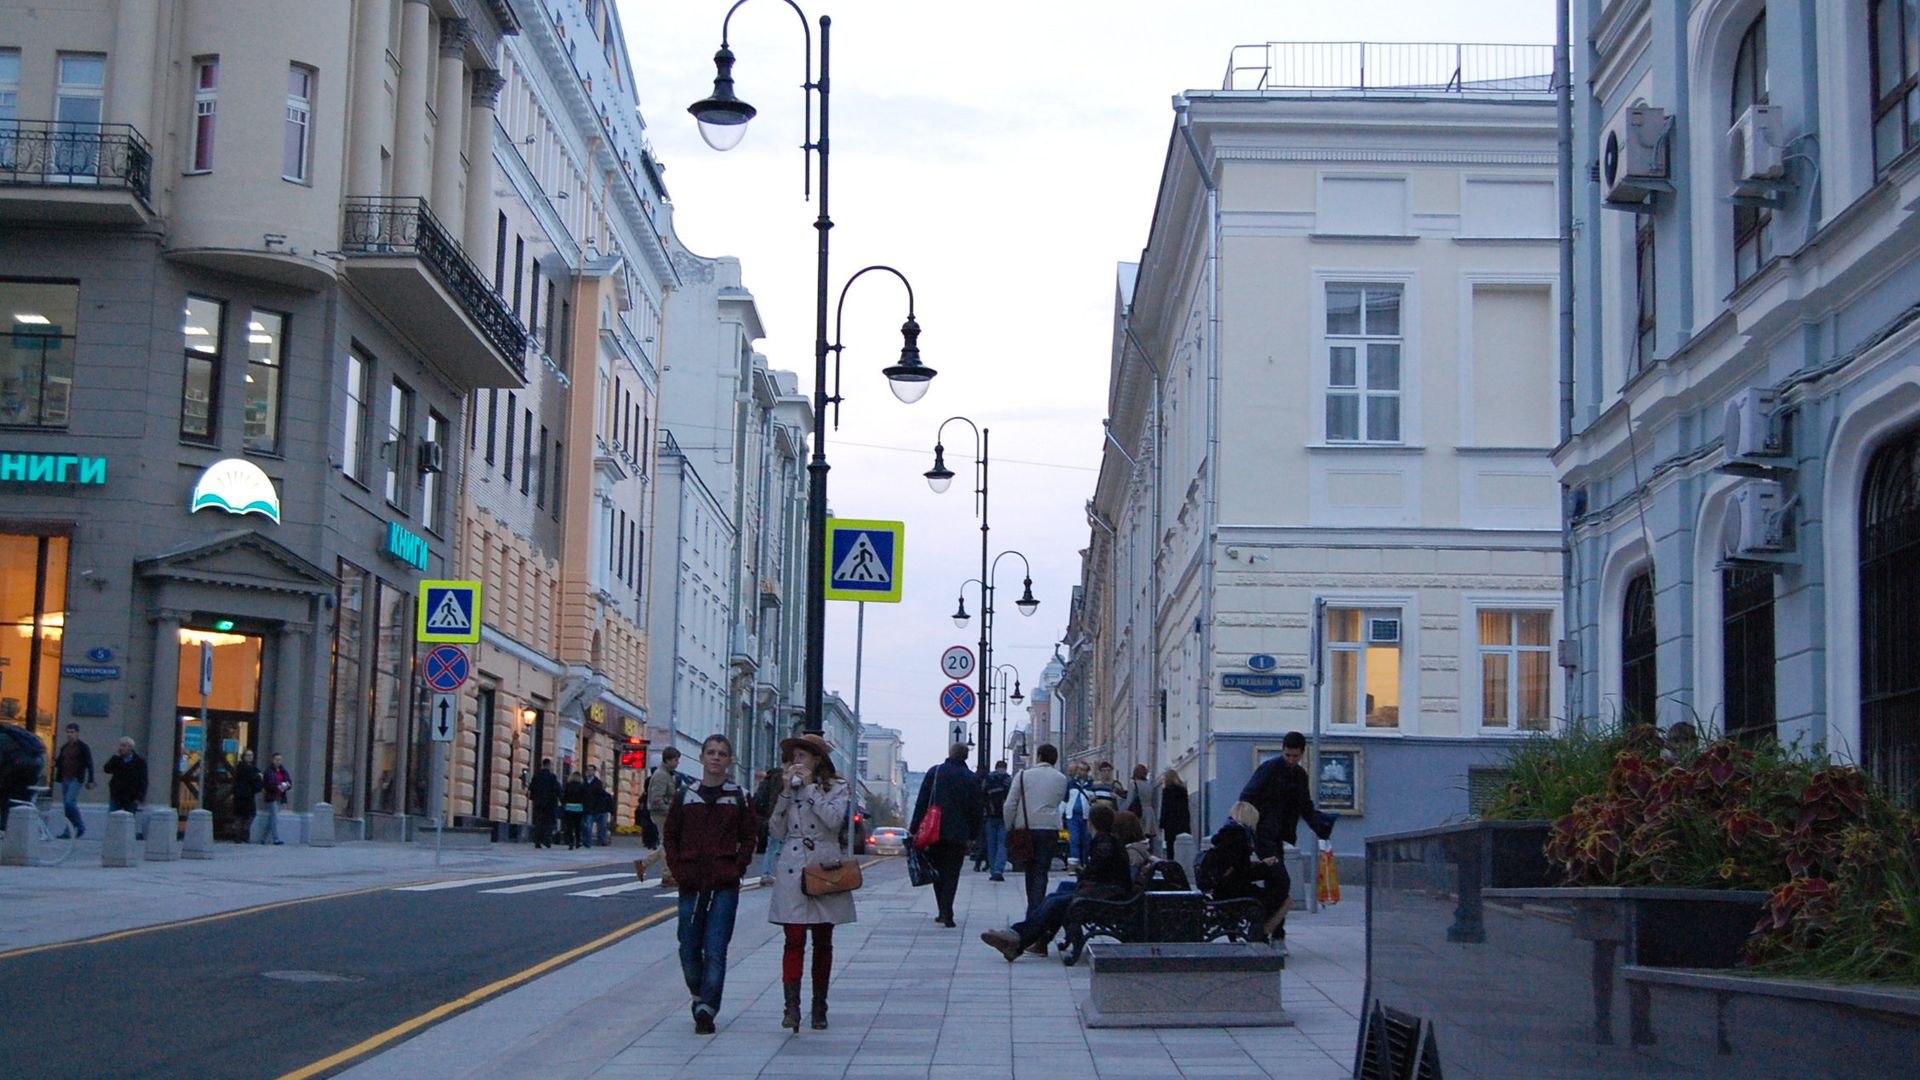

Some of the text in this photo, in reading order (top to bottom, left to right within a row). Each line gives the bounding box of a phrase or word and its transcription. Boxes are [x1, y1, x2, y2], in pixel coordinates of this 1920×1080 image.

[0, 453, 107, 484] НИГИ
[391, 521, 428, 572] КНИГИ
[97, 650, 105, 659] 5
[948, 655, 969, 670] 20
[1278, 678, 1301, 687] МОСТ
